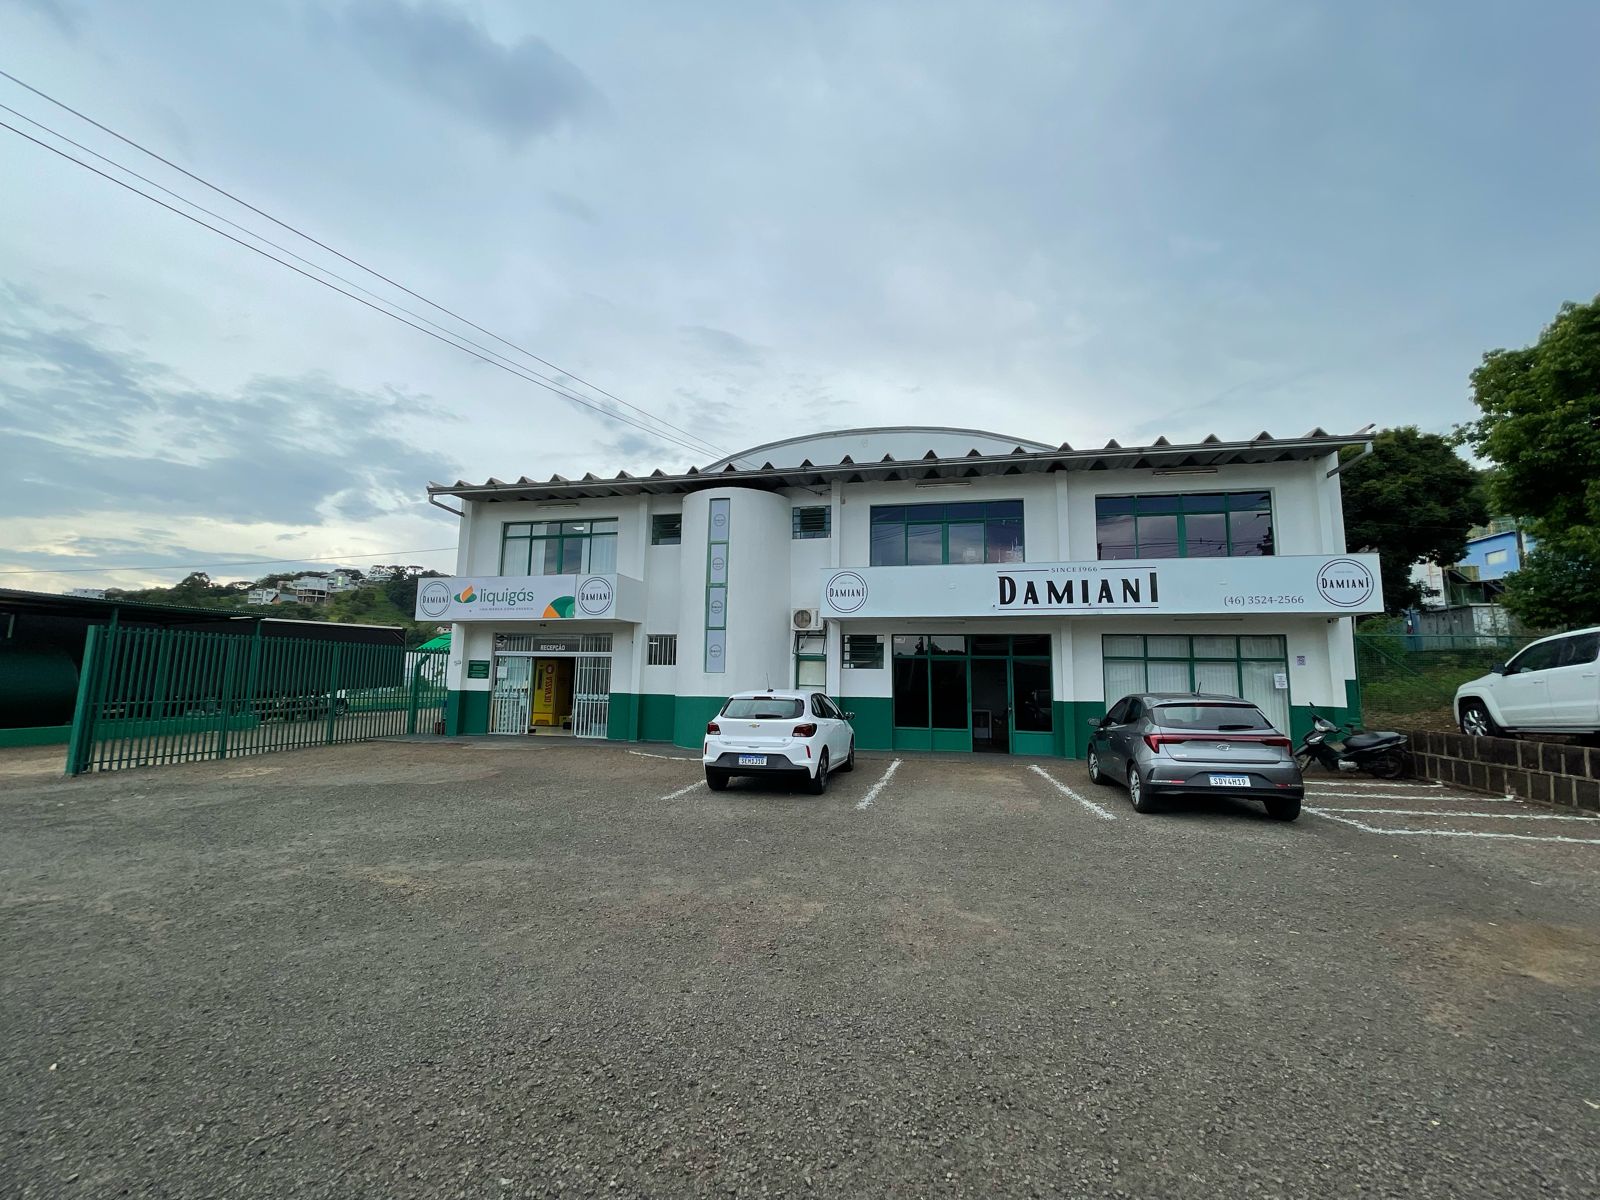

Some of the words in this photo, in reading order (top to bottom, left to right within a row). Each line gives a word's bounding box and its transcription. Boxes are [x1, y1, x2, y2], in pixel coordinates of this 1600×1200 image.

[998, 572, 1159, 605] DAMIANI
[1321, 576, 1369, 589] DAMIANI
[480, 587, 534, 606] liquigás
[581, 591, 610, 601] DAMIANI
[829, 587, 865, 598] DAMIANI
[422, 594, 449, 604] DAMIANI
[1224, 596, 1245, 607] (46)
[1249, 595, 1304, 605] 3524-2566
